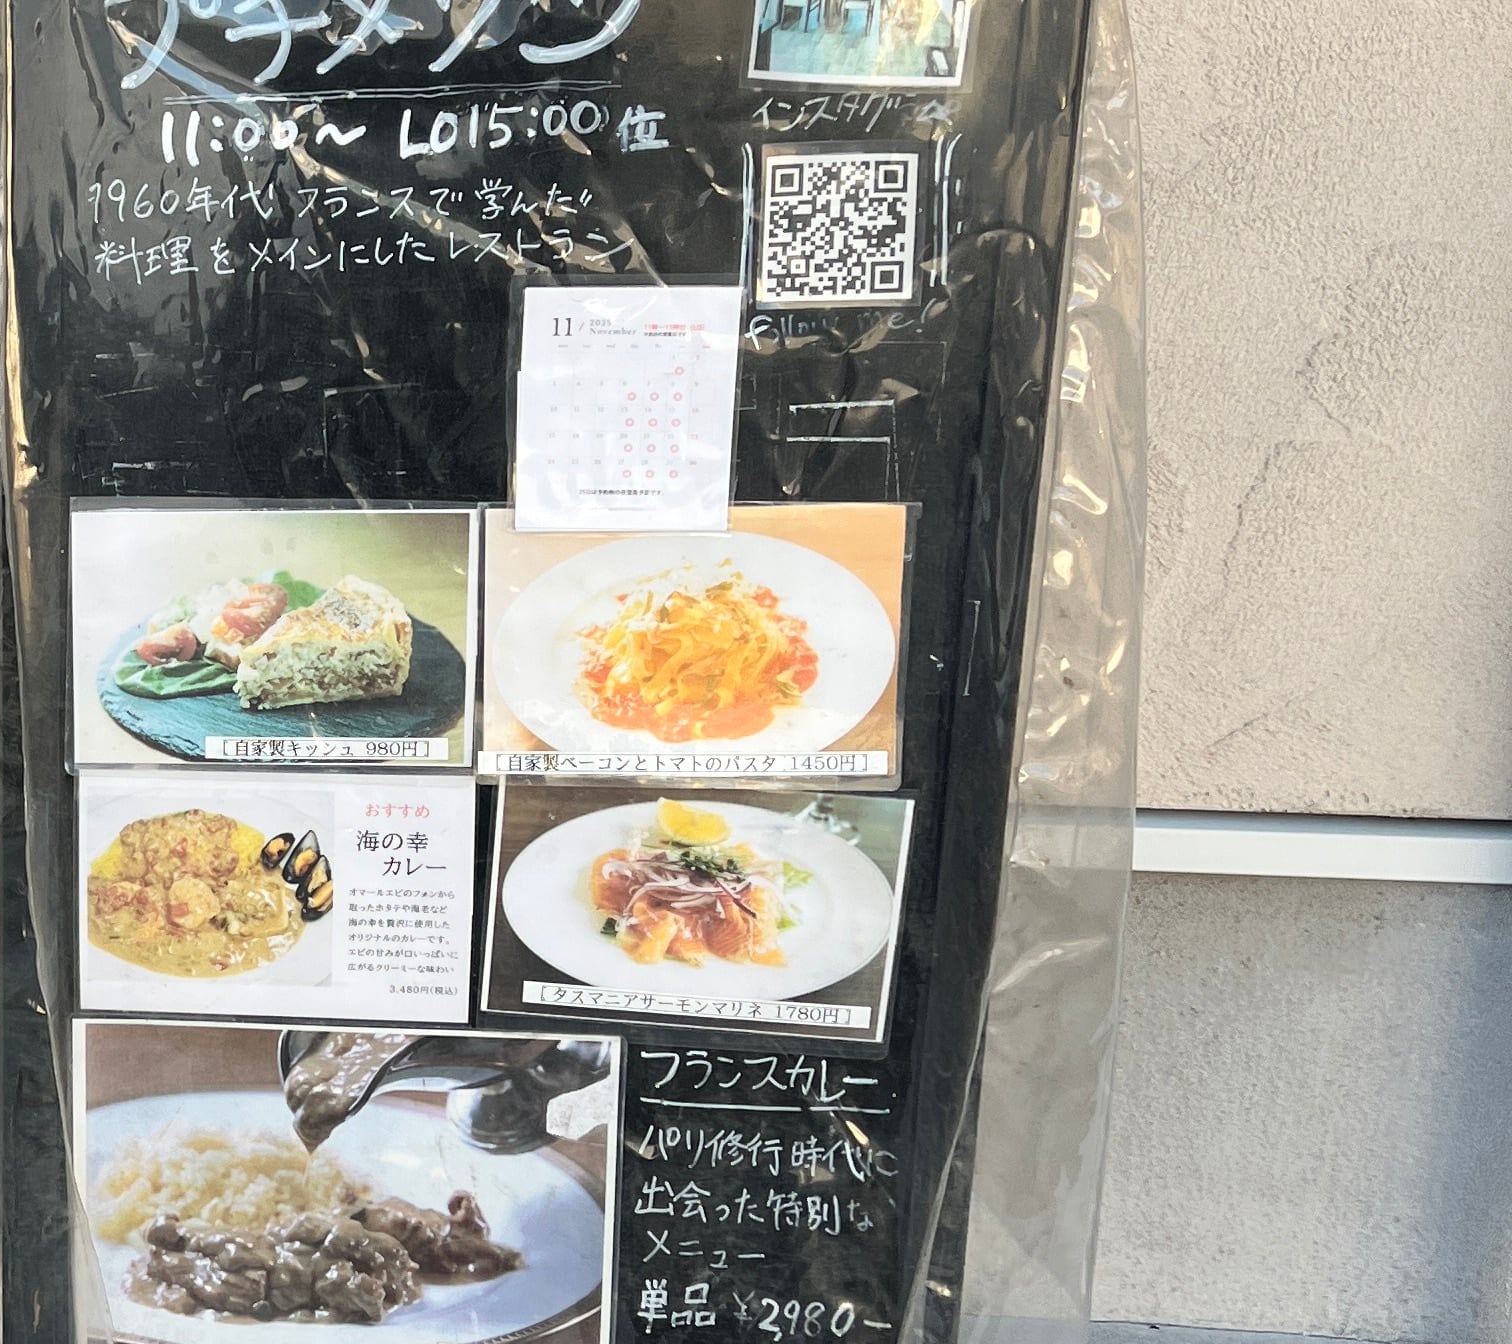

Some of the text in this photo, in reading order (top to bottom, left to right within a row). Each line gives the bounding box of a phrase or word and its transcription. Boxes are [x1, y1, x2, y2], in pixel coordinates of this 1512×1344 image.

[364, 803, 431, 819] おすすめ
[355, 829, 429, 854] 海の幸
[381, 856, 447, 877] カレー
[640, 1051, 879, 1102] フランスカレー
[638, 1124, 900, 1183] パリ修行時代に
[634, 1175, 874, 1235] 出会った特別な
[642, 1229, 766, 1269] メニュー
[637, 1277, 717, 1334] 単品
